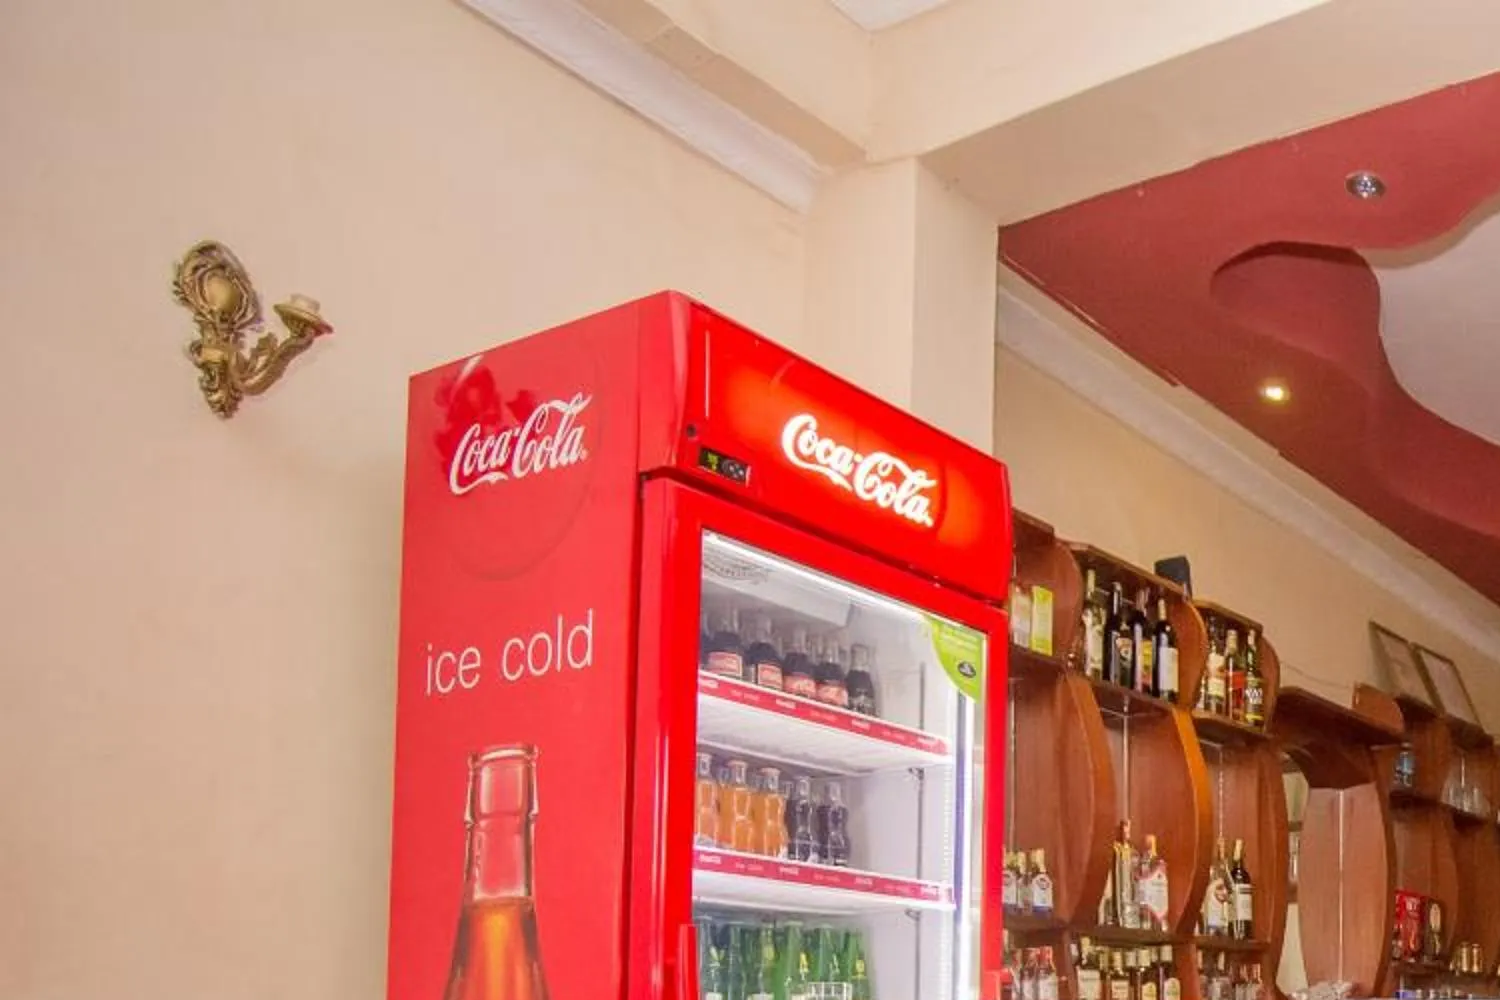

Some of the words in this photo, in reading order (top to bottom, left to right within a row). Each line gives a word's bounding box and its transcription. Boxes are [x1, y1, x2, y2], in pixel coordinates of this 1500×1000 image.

[449, 391, 593, 495] Coca-Cola
[782, 413, 937, 527] Coca-Cola
[426, 643, 481, 696] ice
[502, 607, 593, 681] cold
